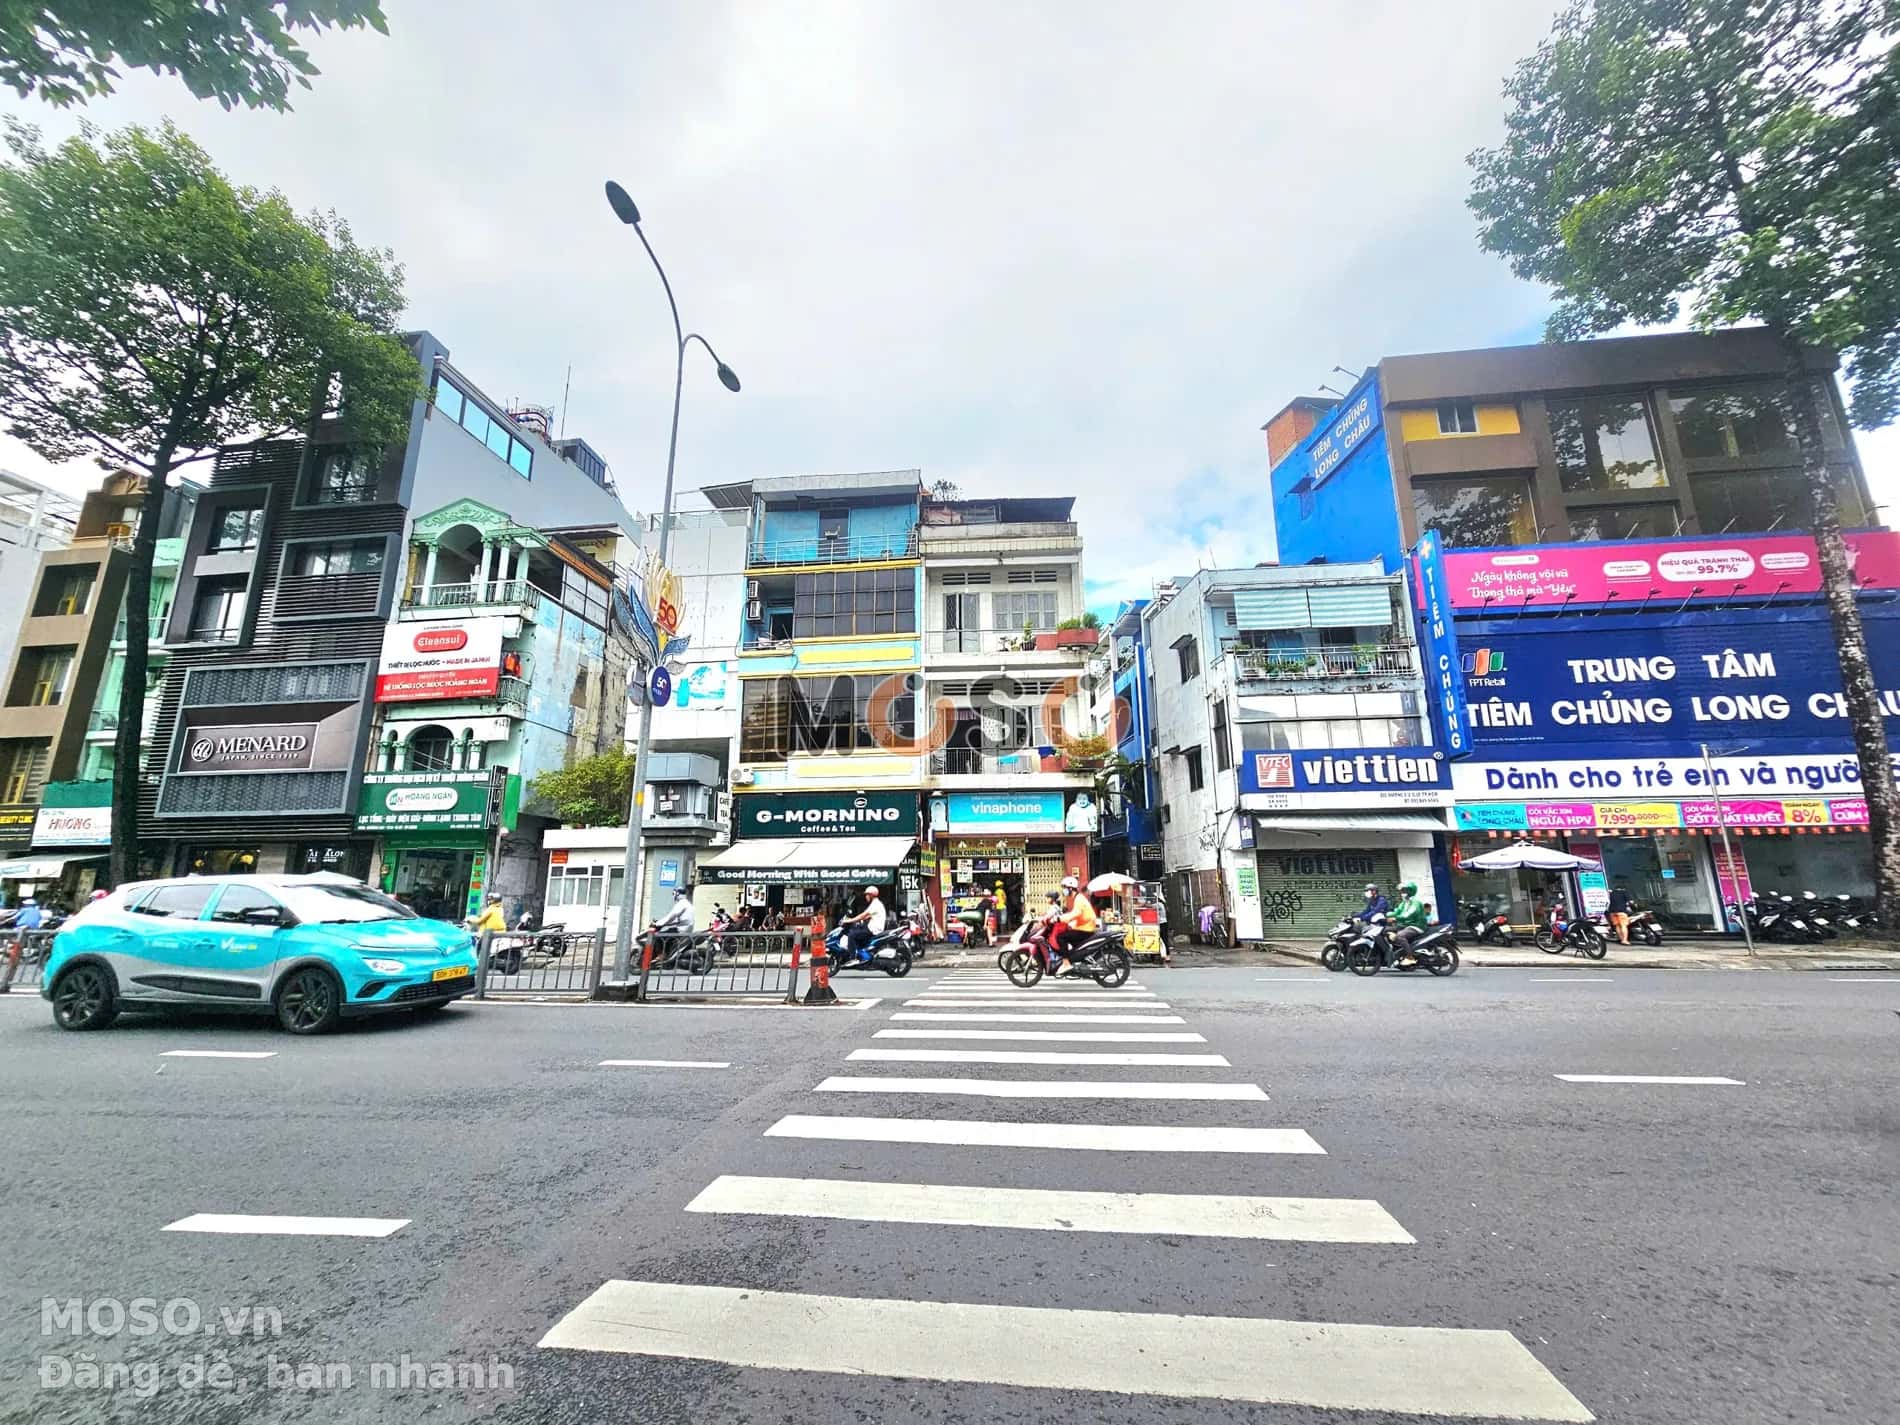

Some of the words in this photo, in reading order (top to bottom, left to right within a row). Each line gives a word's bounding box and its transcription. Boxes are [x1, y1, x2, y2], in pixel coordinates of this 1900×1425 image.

[1315, 448, 1339, 479] LONG
[1568, 656, 1676, 684] TRUNG
[1702, 649, 1776, 679] TÂM
[1469, 678, 1485, 687] FPT
[1467, 696, 1533, 728] TIÊM
[1551, 690, 1673, 726] CHỦNG
[1693, 694, 1790, 722] LONG
[216, 735, 307, 753] MENARD
[1302, 755, 1439, 785] viettien
[1486, 766, 1558, 791] Dành
[1569, 767, 1622, 788] cho
[1633, 762, 1674, 787] trẻ
[1740, 761, 1776, 785] và
[972, 802, 1042, 816] vinaphone
[1792, 810, 1821, 823] 8%
[1567, 815, 1592, 825] HPV
[840, 825, 856, 833] Tea
[717, 870, 745, 879] Good
[747, 870, 792, 880] Morning
[793, 870, 819, 878] With
[820, 870, 850, 878] Good
[851, 869, 889, 878] Coffee
[901, 875, 919, 890] 15k
